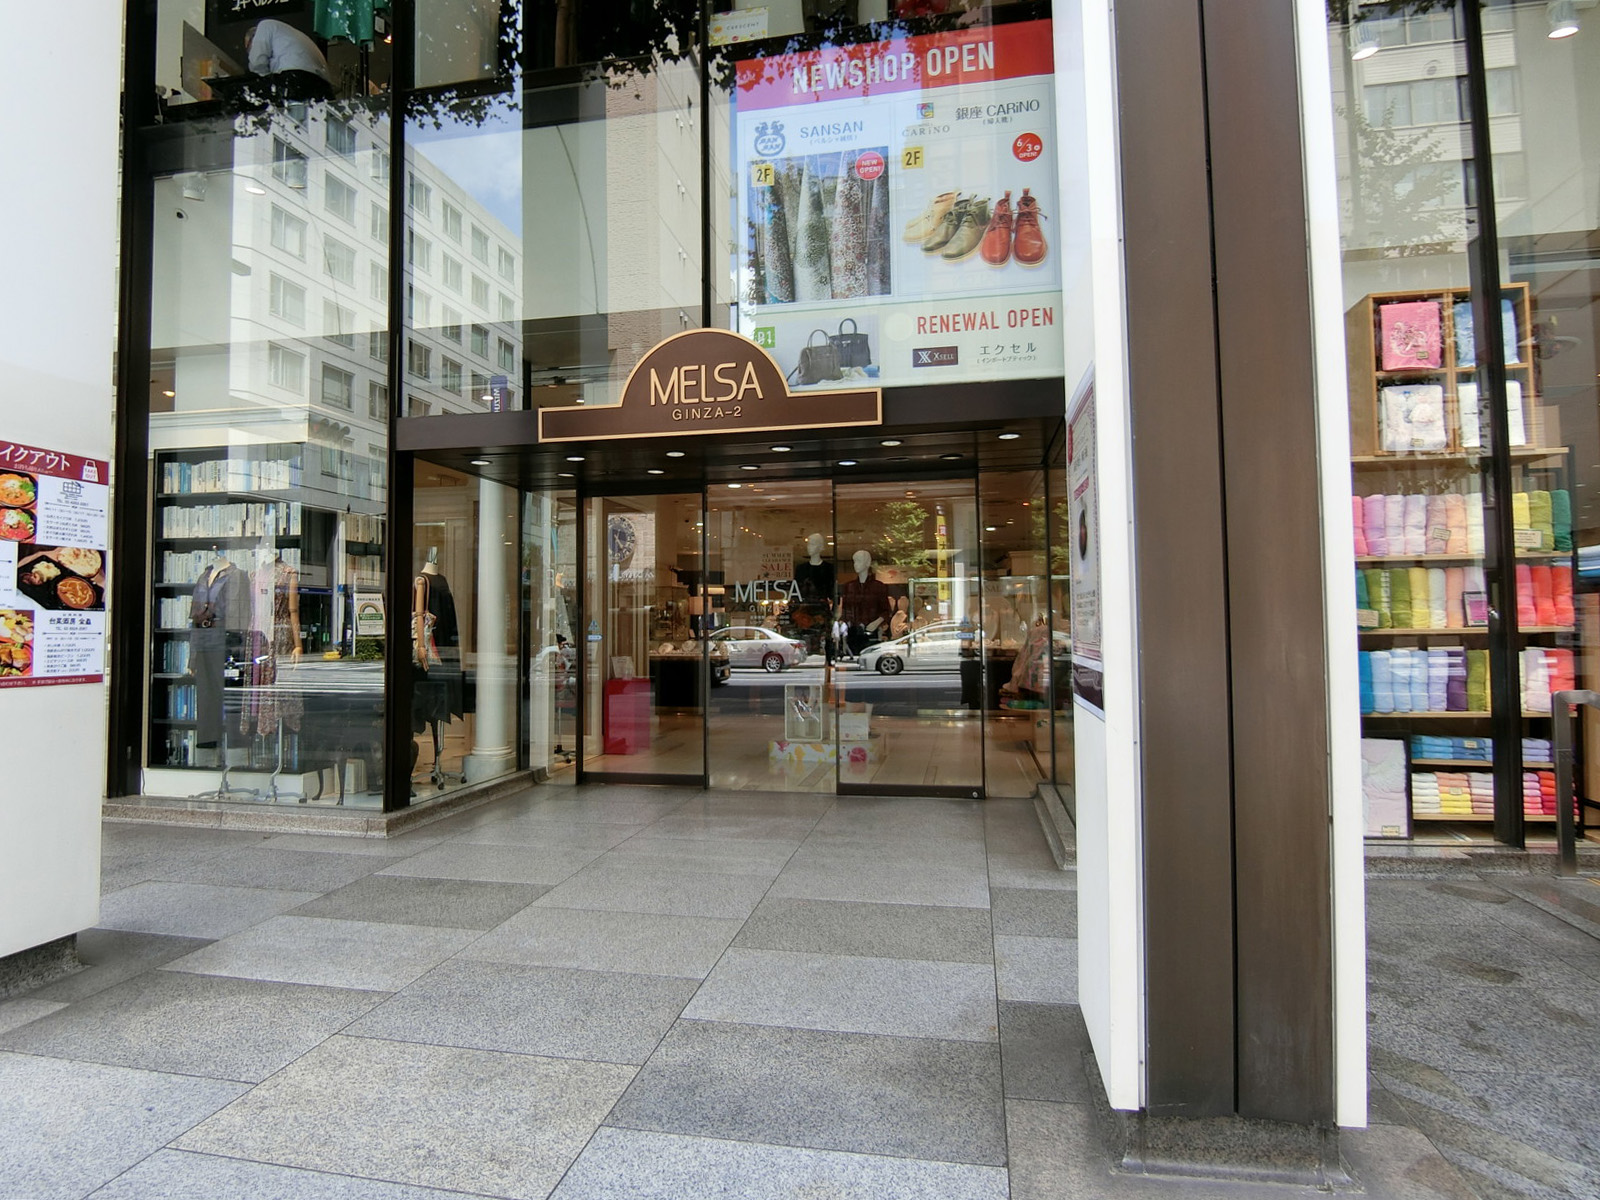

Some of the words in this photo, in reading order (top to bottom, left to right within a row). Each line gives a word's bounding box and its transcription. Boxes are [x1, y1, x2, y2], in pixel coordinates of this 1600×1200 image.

[926, 41, 995, 78] OPEN
[955, 105, 983, 121] 銀座
[800, 120, 863, 139] SANSAN
[861, 159, 878, 167] NEW
[905, 150, 921, 166] 2F
[756, 168, 771, 183] 2F
[917, 311, 1000, 335] RENEWAL
[1007, 306, 1054, 329] OPEN
[979, 342, 1037, 356] エクセル
[650, 361, 764, 406] MELSA
[672, 406, 743, 421] GINZA-2
[761, 562, 792, 571] SALE
[735, 580, 803, 603] MELSA
